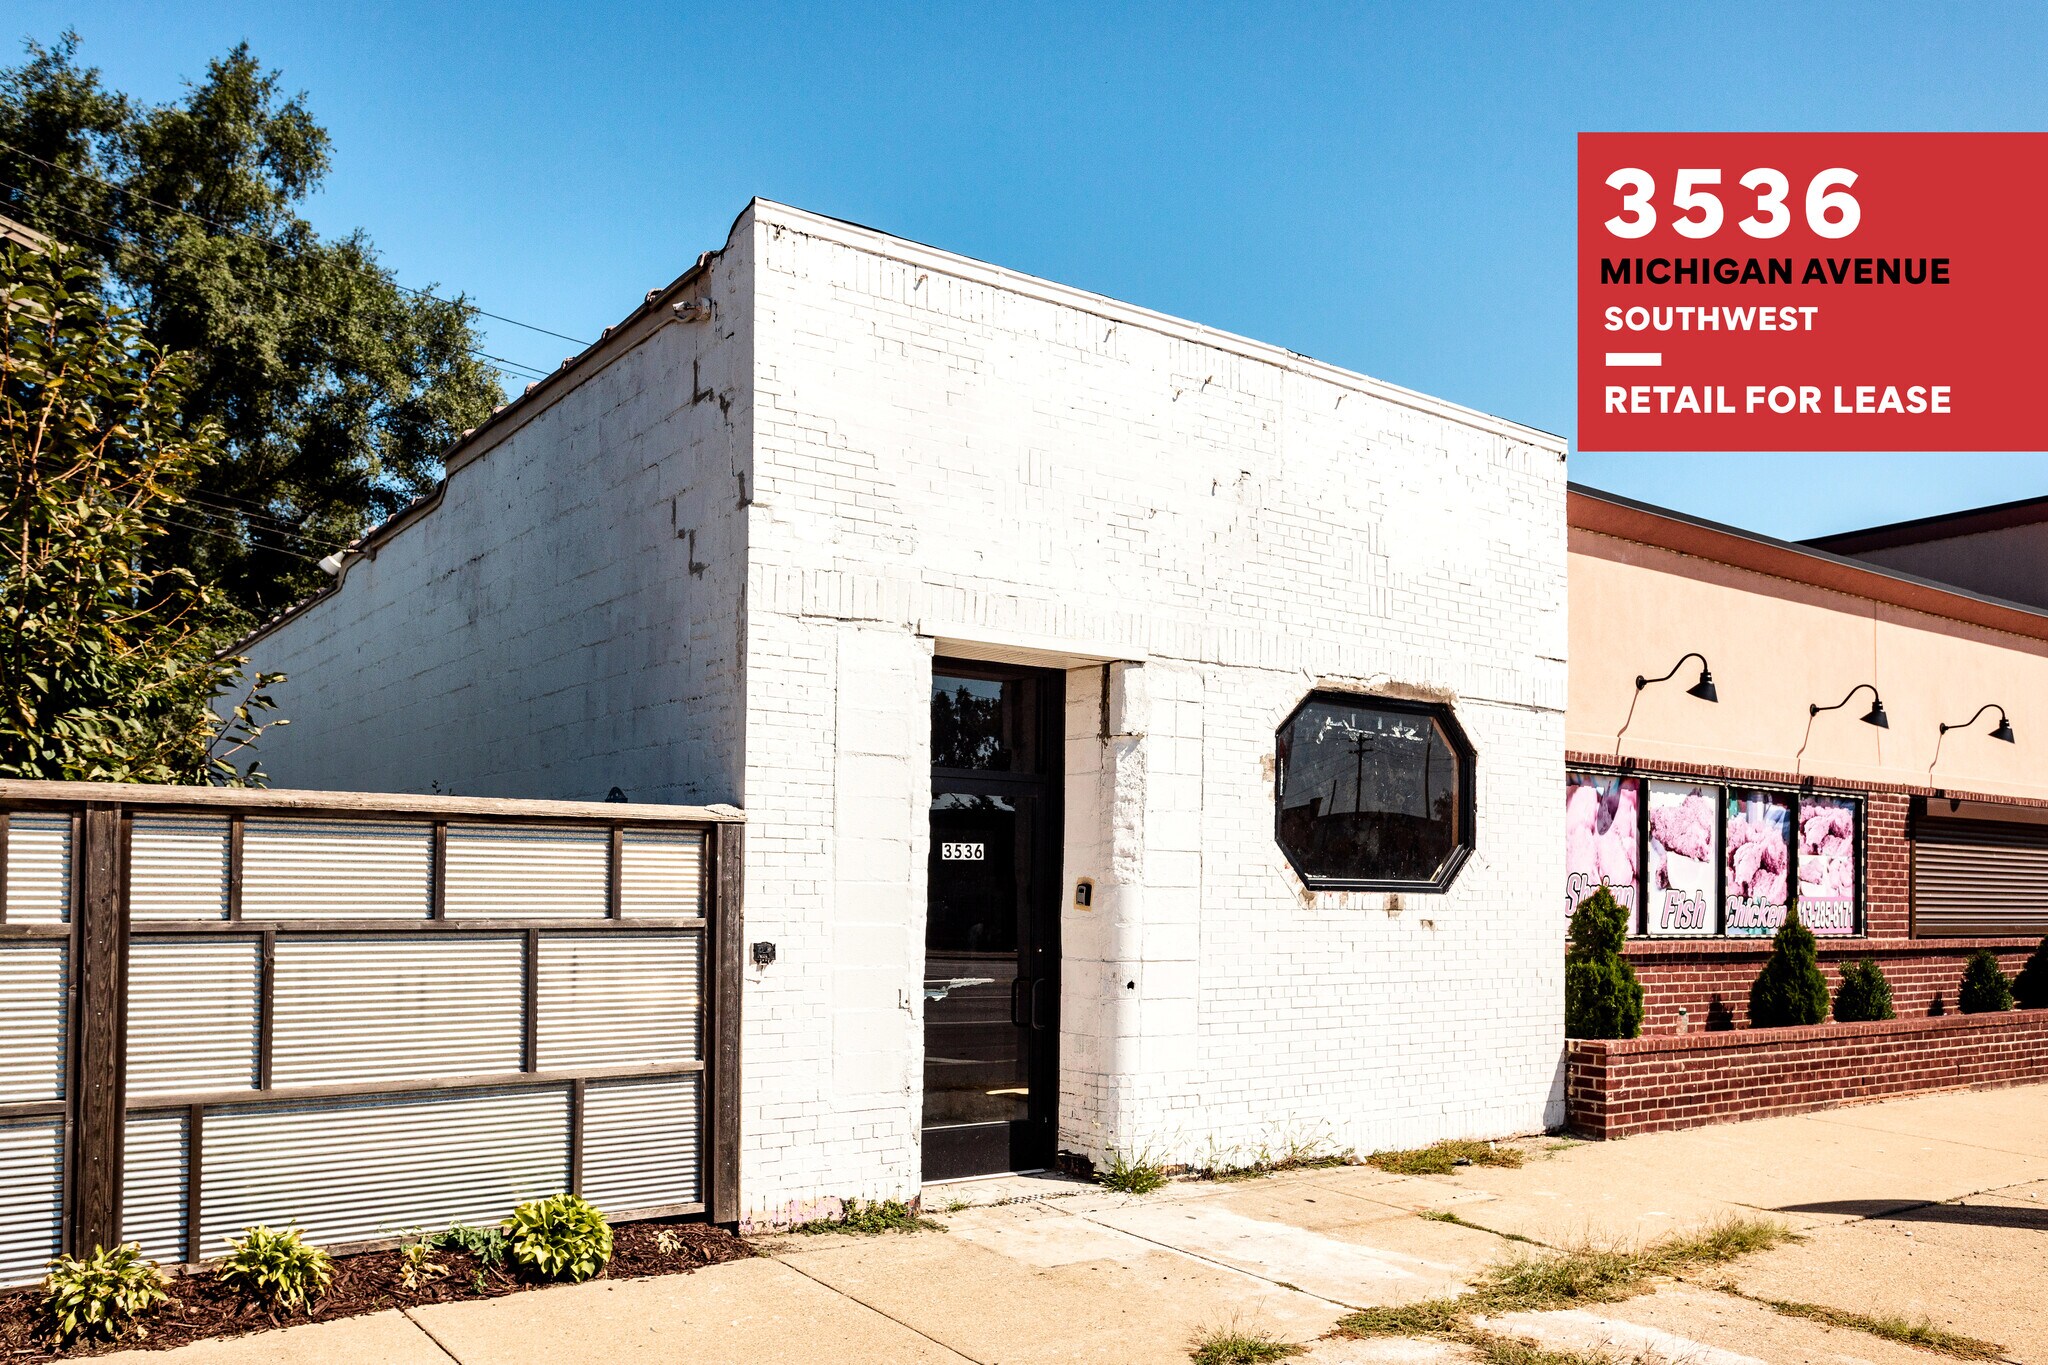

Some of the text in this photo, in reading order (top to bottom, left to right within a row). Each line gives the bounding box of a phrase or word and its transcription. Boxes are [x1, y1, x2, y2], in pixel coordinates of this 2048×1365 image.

[943, 843, 983, 859] 3536
[1661, 888, 1707, 930] Fish
[1726, 895, 1787, 929] Chicken
